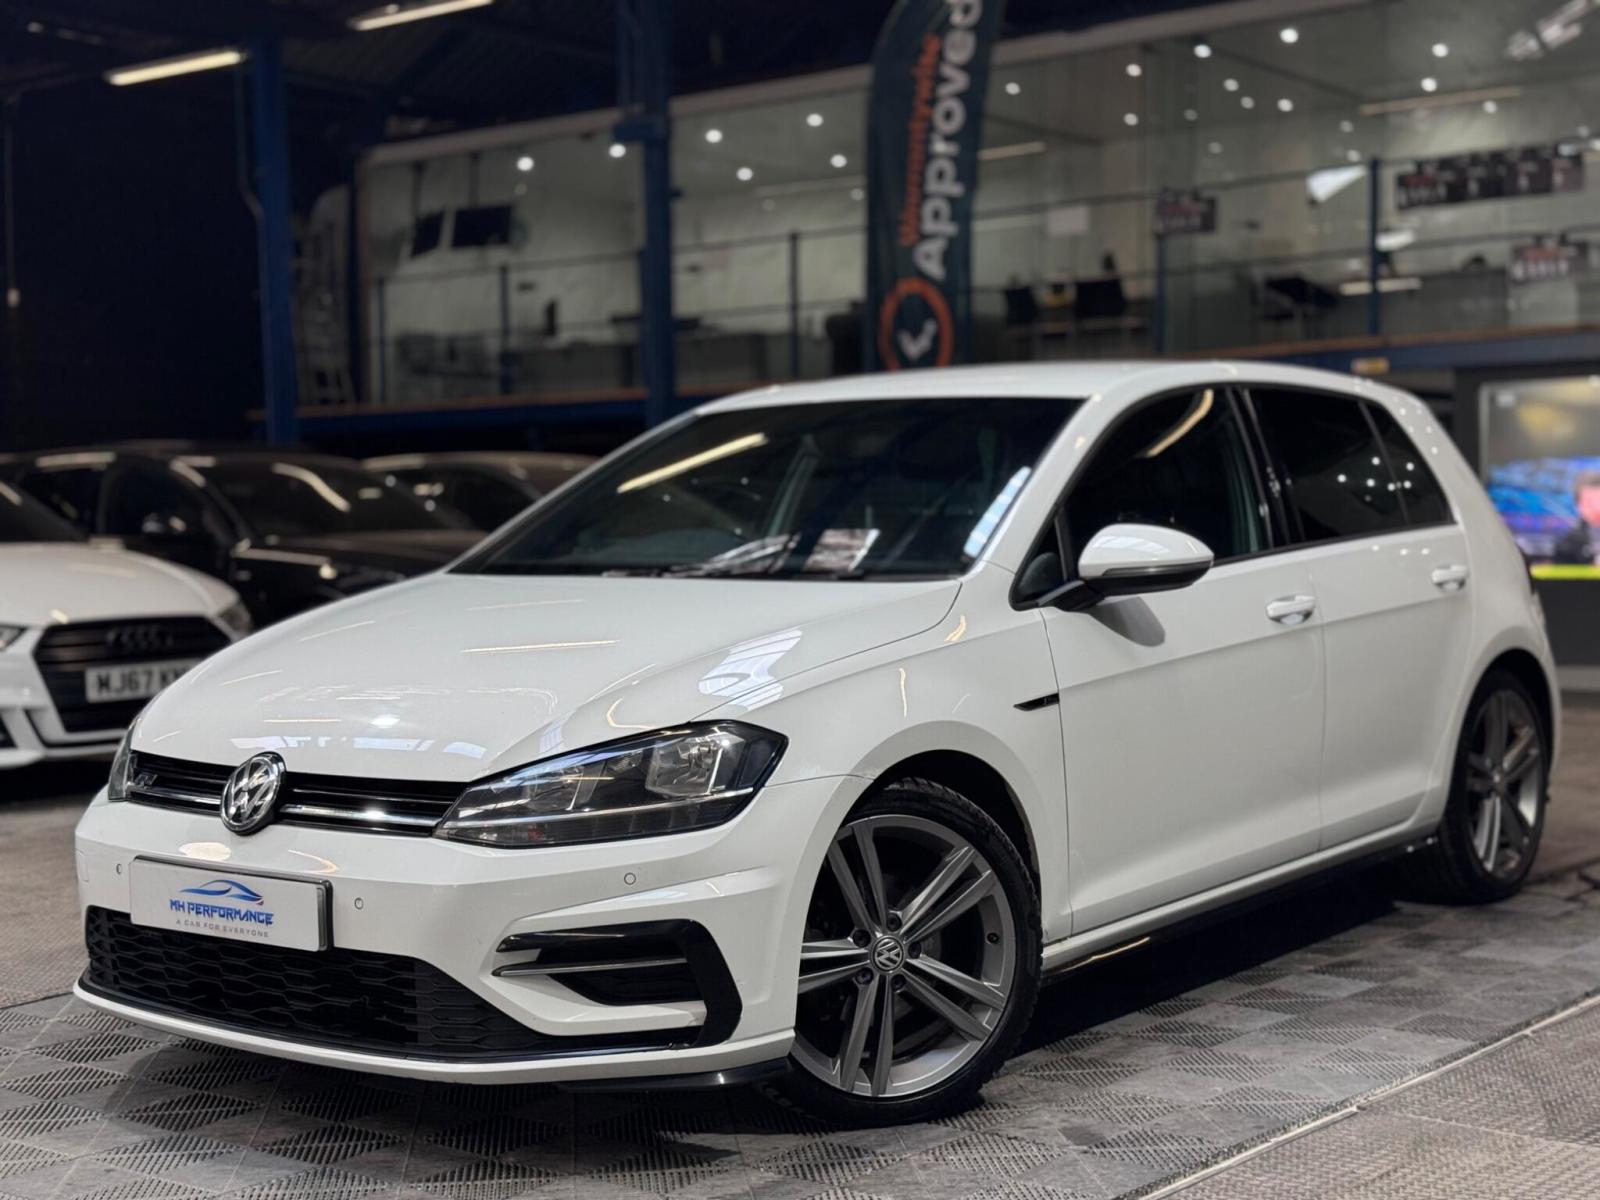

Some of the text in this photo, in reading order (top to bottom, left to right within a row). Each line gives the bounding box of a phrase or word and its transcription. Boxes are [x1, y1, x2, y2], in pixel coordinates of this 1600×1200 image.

[912, 0, 984, 282] Approved
[169, 899, 274, 926] MH PERFORMANCE
[184, 920, 201, 928] CAR
[203, 922, 220, 931] FOR
[223, 926, 269, 938] EVERYONE
